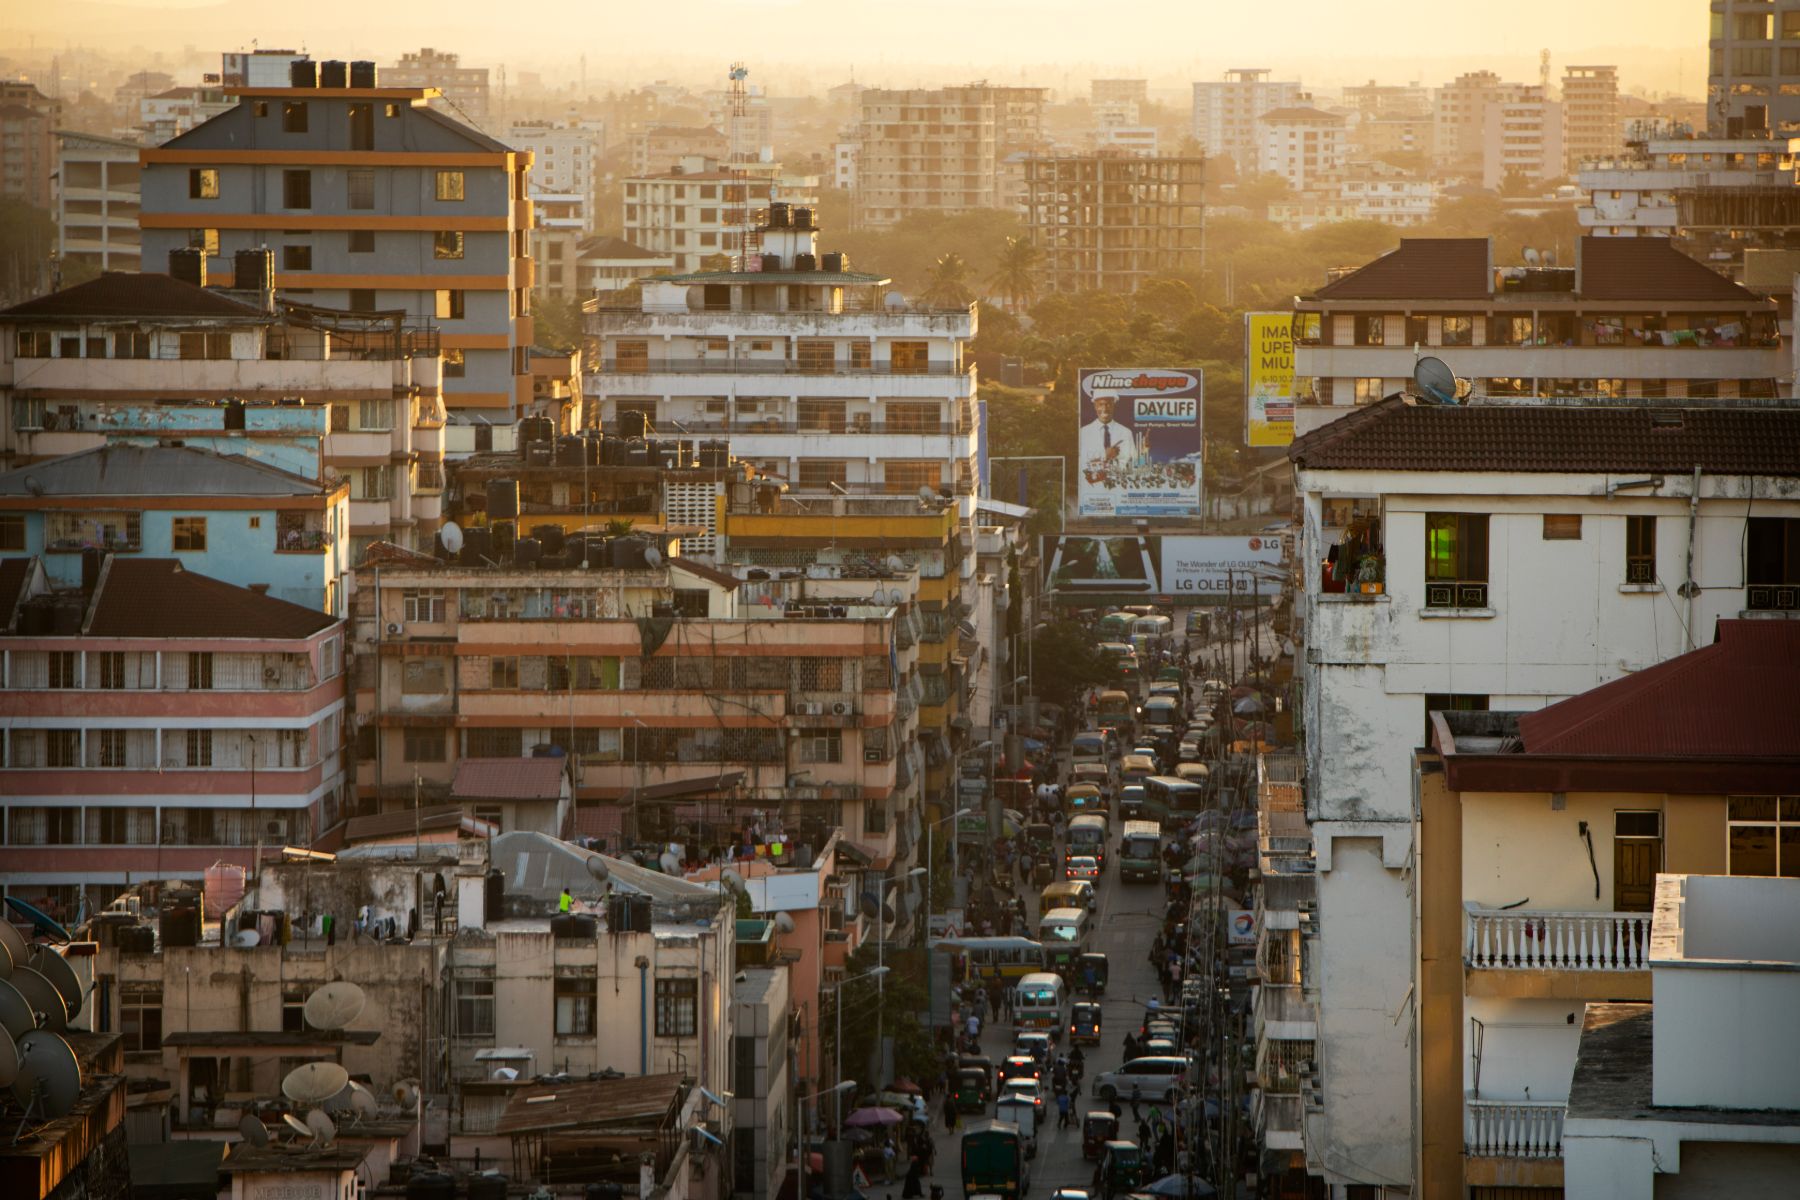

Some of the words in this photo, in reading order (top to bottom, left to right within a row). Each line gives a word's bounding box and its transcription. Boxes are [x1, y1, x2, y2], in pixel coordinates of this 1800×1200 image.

[1262, 326, 1289, 338] IMA
[1262, 357, 1294, 369] MIU
[1138, 402, 1194, 416] DAYLIFF
[1264, 540, 1279, 549] LG
[1176, 560, 1189, 568] The
[1190, 560, 1217, 568] Wonder
[1218, 560, 1226, 568] of
[1227, 560, 1235, 568] LG
[1237, 560, 1258, 568] OLED
[1176, 579, 1193, 590] LG
[1198, 579, 1233, 590] OLED
